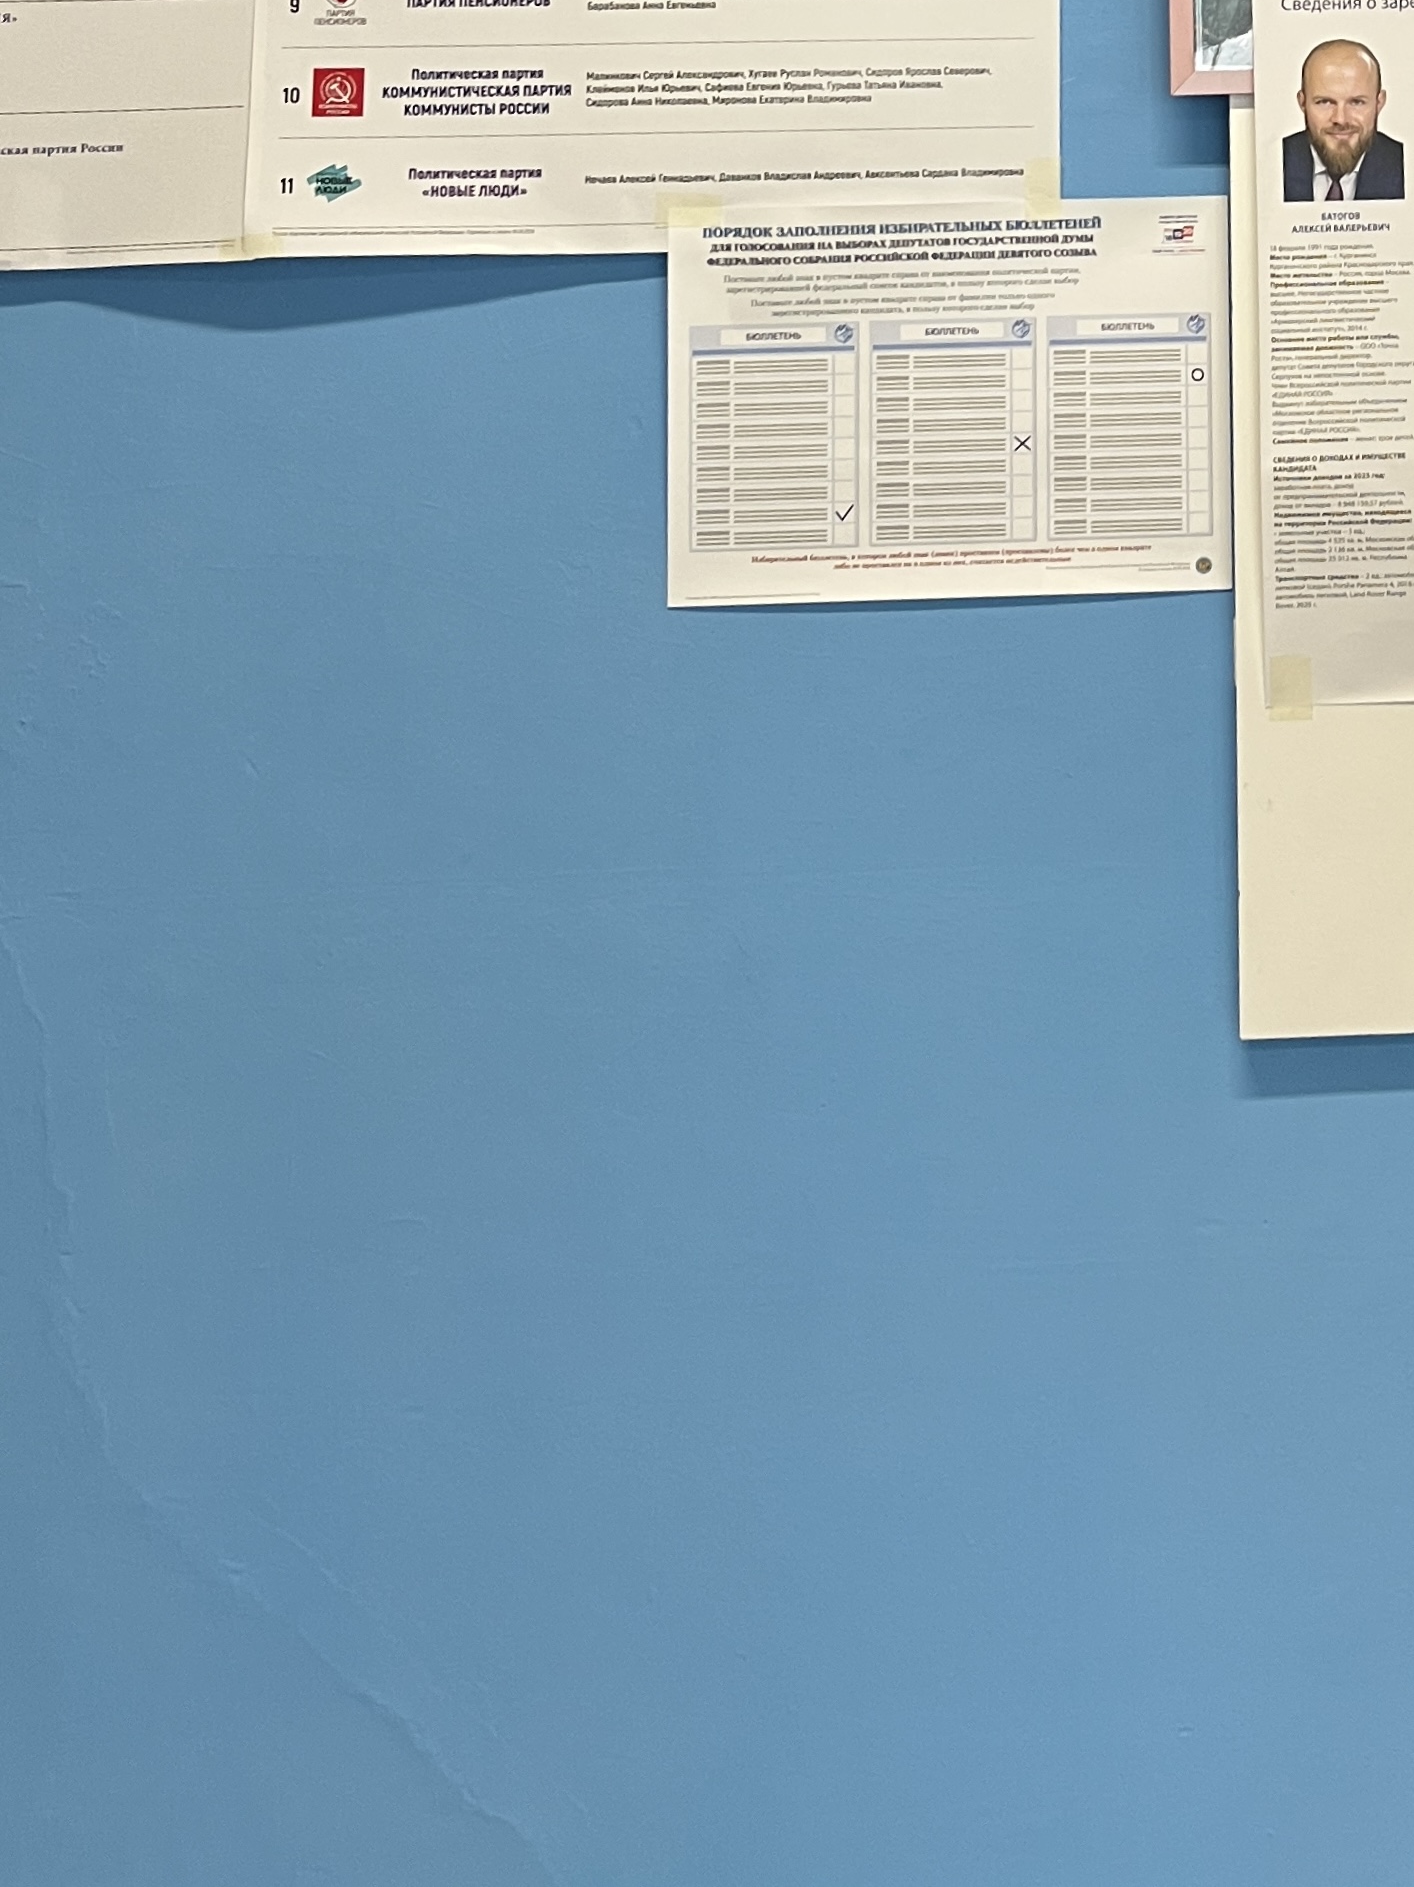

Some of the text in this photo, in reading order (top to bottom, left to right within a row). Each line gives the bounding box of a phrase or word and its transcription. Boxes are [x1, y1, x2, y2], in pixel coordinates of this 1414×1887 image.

[282, 86, 300, 104] 10
[403, 101, 550, 116] КОММУНИСТЫ РОССИИ
[31, 145, 77, 157] партия
[80, 142, 124, 153] России
[279, 177, 294, 194] 11
[421, 183, 528, 198] «НОВЫЕ ЛЮДИ»
[702, 215, 1102, 238] ПОРЯДОК ЗАПОЛНЕНИЯ ИЗБИРАТЕЛЬНЫХ БЮЛЛЕТЕНЕЙ
